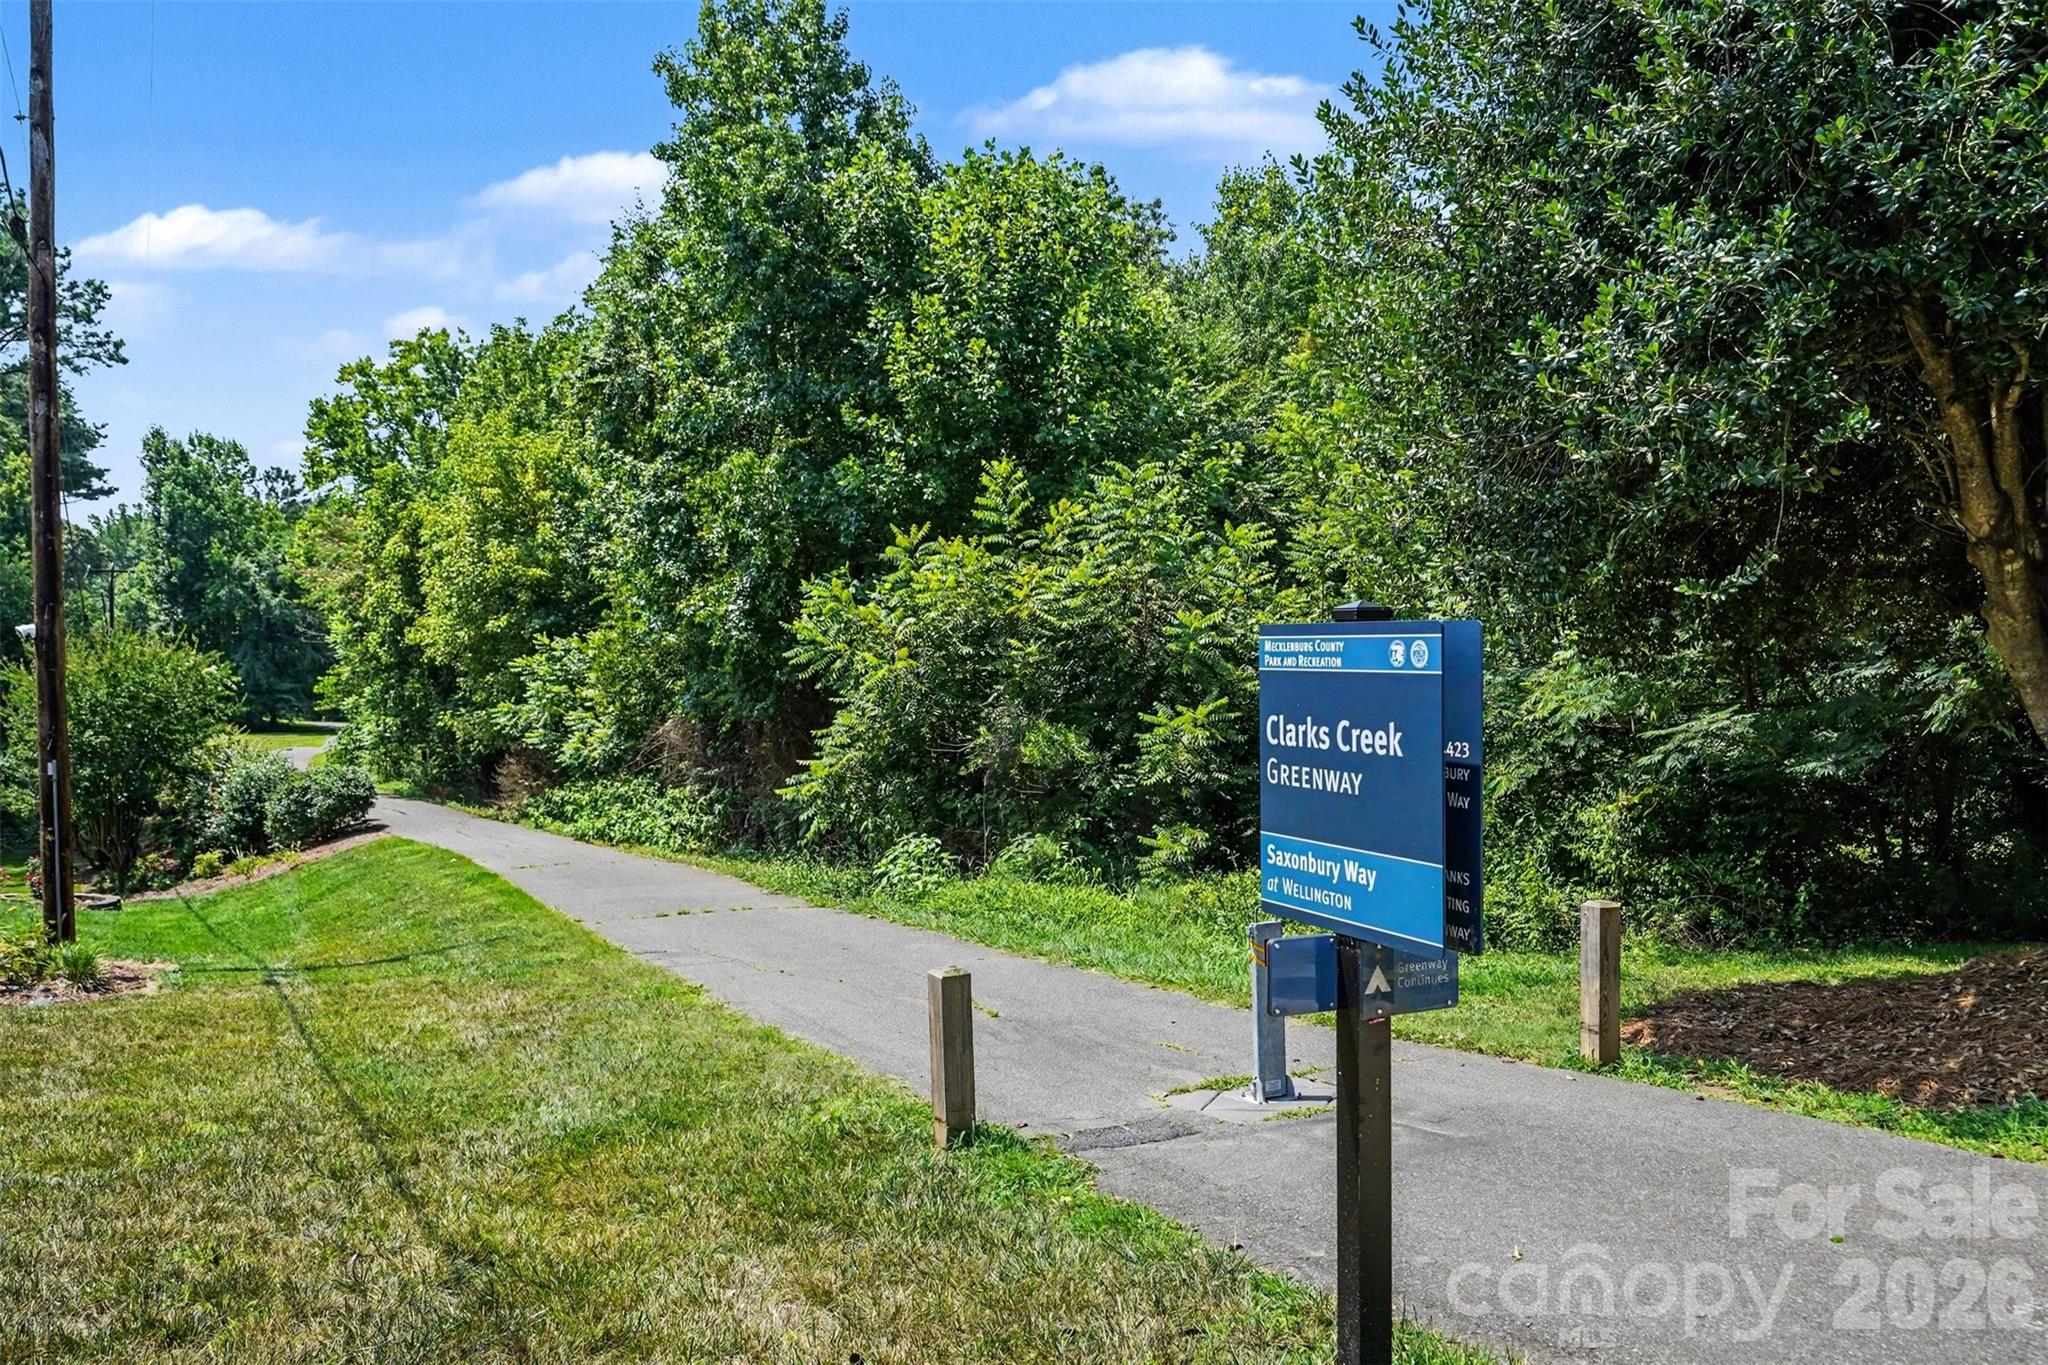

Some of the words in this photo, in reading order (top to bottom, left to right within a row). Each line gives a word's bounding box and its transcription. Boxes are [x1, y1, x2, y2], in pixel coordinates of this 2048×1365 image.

[1264, 640, 1313, 652] MECKLENBURG
[1314, 639, 1344, 652] COUNTY
[1264, 654, 1281, 667] PARK
[1283, 656, 1297, 667] AND
[1298, 655, 1342, 668] RECREATION
[1266, 714, 1330, 750] Clarks
[1336, 720, 1404, 757] Creek
[1444, 741, 1470, 758] 423
[1266, 757, 1363, 796] GREENWAY
[1447, 791, 1470, 809] WAY
[1267, 843, 1341, 885] Saxonbury
[1343, 859, 1377, 892] Way
[1267, 876, 1279, 893] at
[1282, 877, 1352, 911] WELLINGTON
[1445, 924, 1471, 941] WAY
[1397, 959, 1449, 973] Greenway
[1397, 973, 1450, 988] Continues
